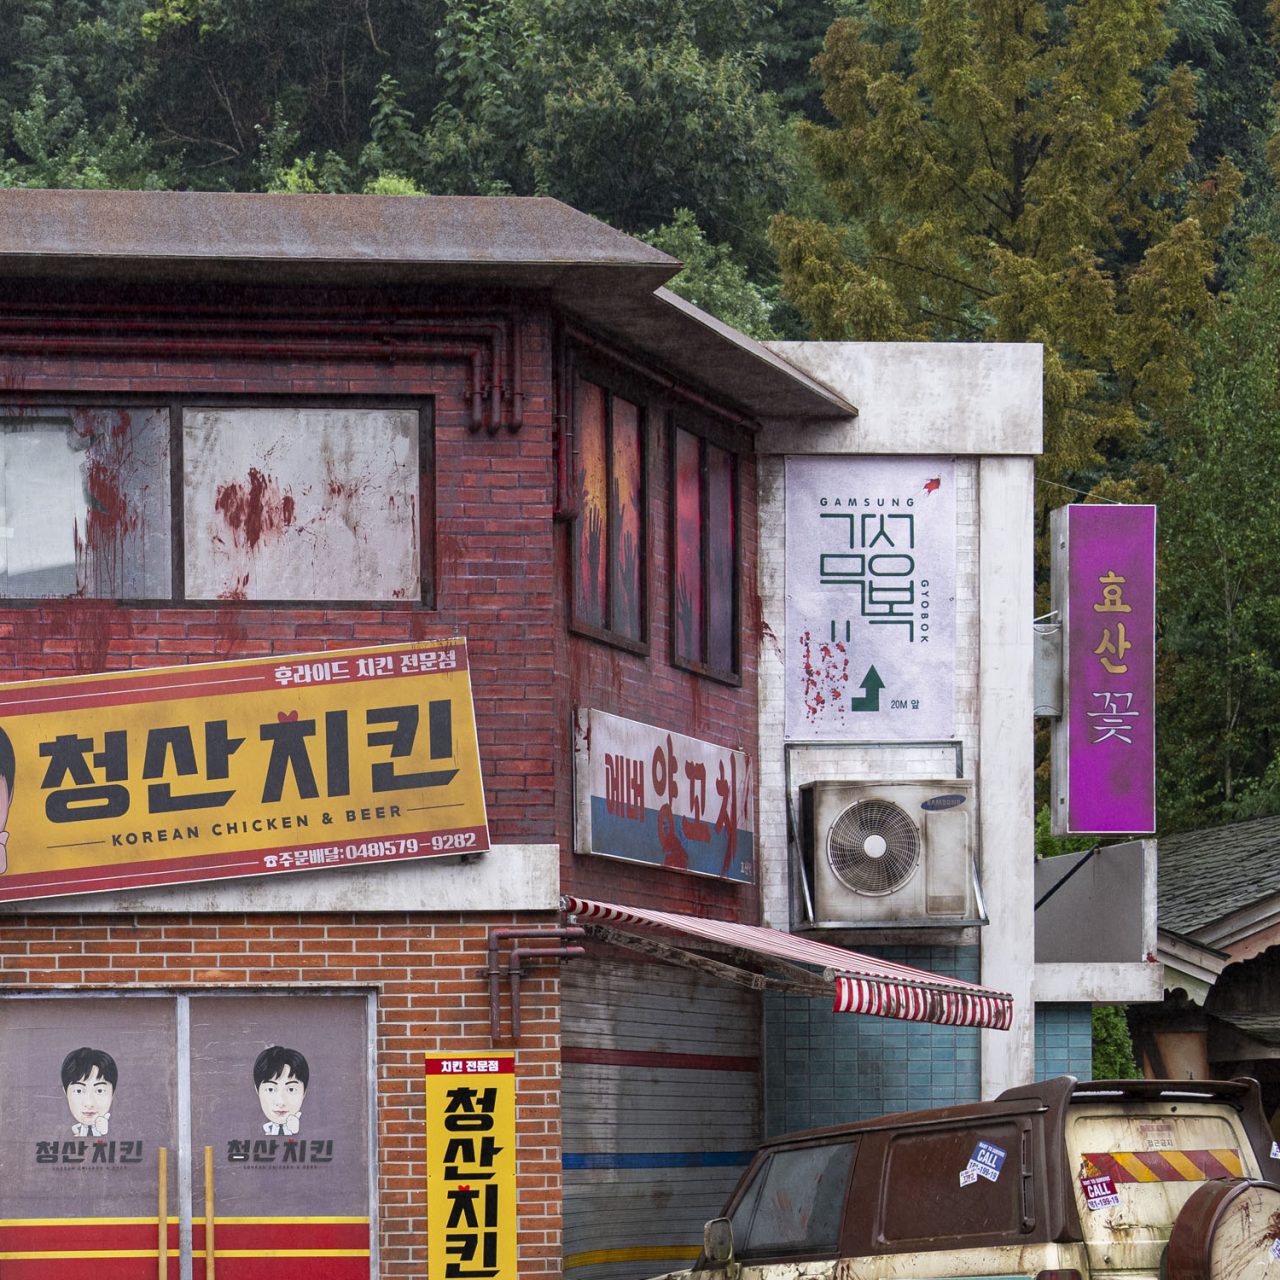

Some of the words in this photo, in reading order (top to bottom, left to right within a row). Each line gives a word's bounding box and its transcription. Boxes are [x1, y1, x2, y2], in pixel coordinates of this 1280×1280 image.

[820, 497, 915, 507] GAMSUNG
[920, 579, 930, 643] GYOBOK
[1093, 570, 1132, 674] 효산
[274, 661, 351, 685] 후라이드
[356, 656, 393, 677] 치킨
[400, 650, 456, 673] 전문점
[890, 700, 908, 710] 20M
[910, 699, 920, 710] 앞
[1087, 692, 1139, 744] 꽃
[39, 698, 460, 824] 청산치킨
[652, 733, 737, 874] 양꼬치
[112, 826, 200, 847] KOREAN
[212, 814, 309, 837] CHICKEN
[322, 812, 333, 825] &
[346, 805, 401, 823] BEER
[441, 1060, 463, 1072] 치킨
[466, 1060, 499, 1072] 전문점
[35, 1140, 143, 1164] 청산치킨
[227, 1139, 334, 1163] 청산치킨
[977, 1149, 998, 1168] CALL
[443, 1087, 504, 1278] 청산치킨
[1087, 1184, 1111, 1198] CALL
